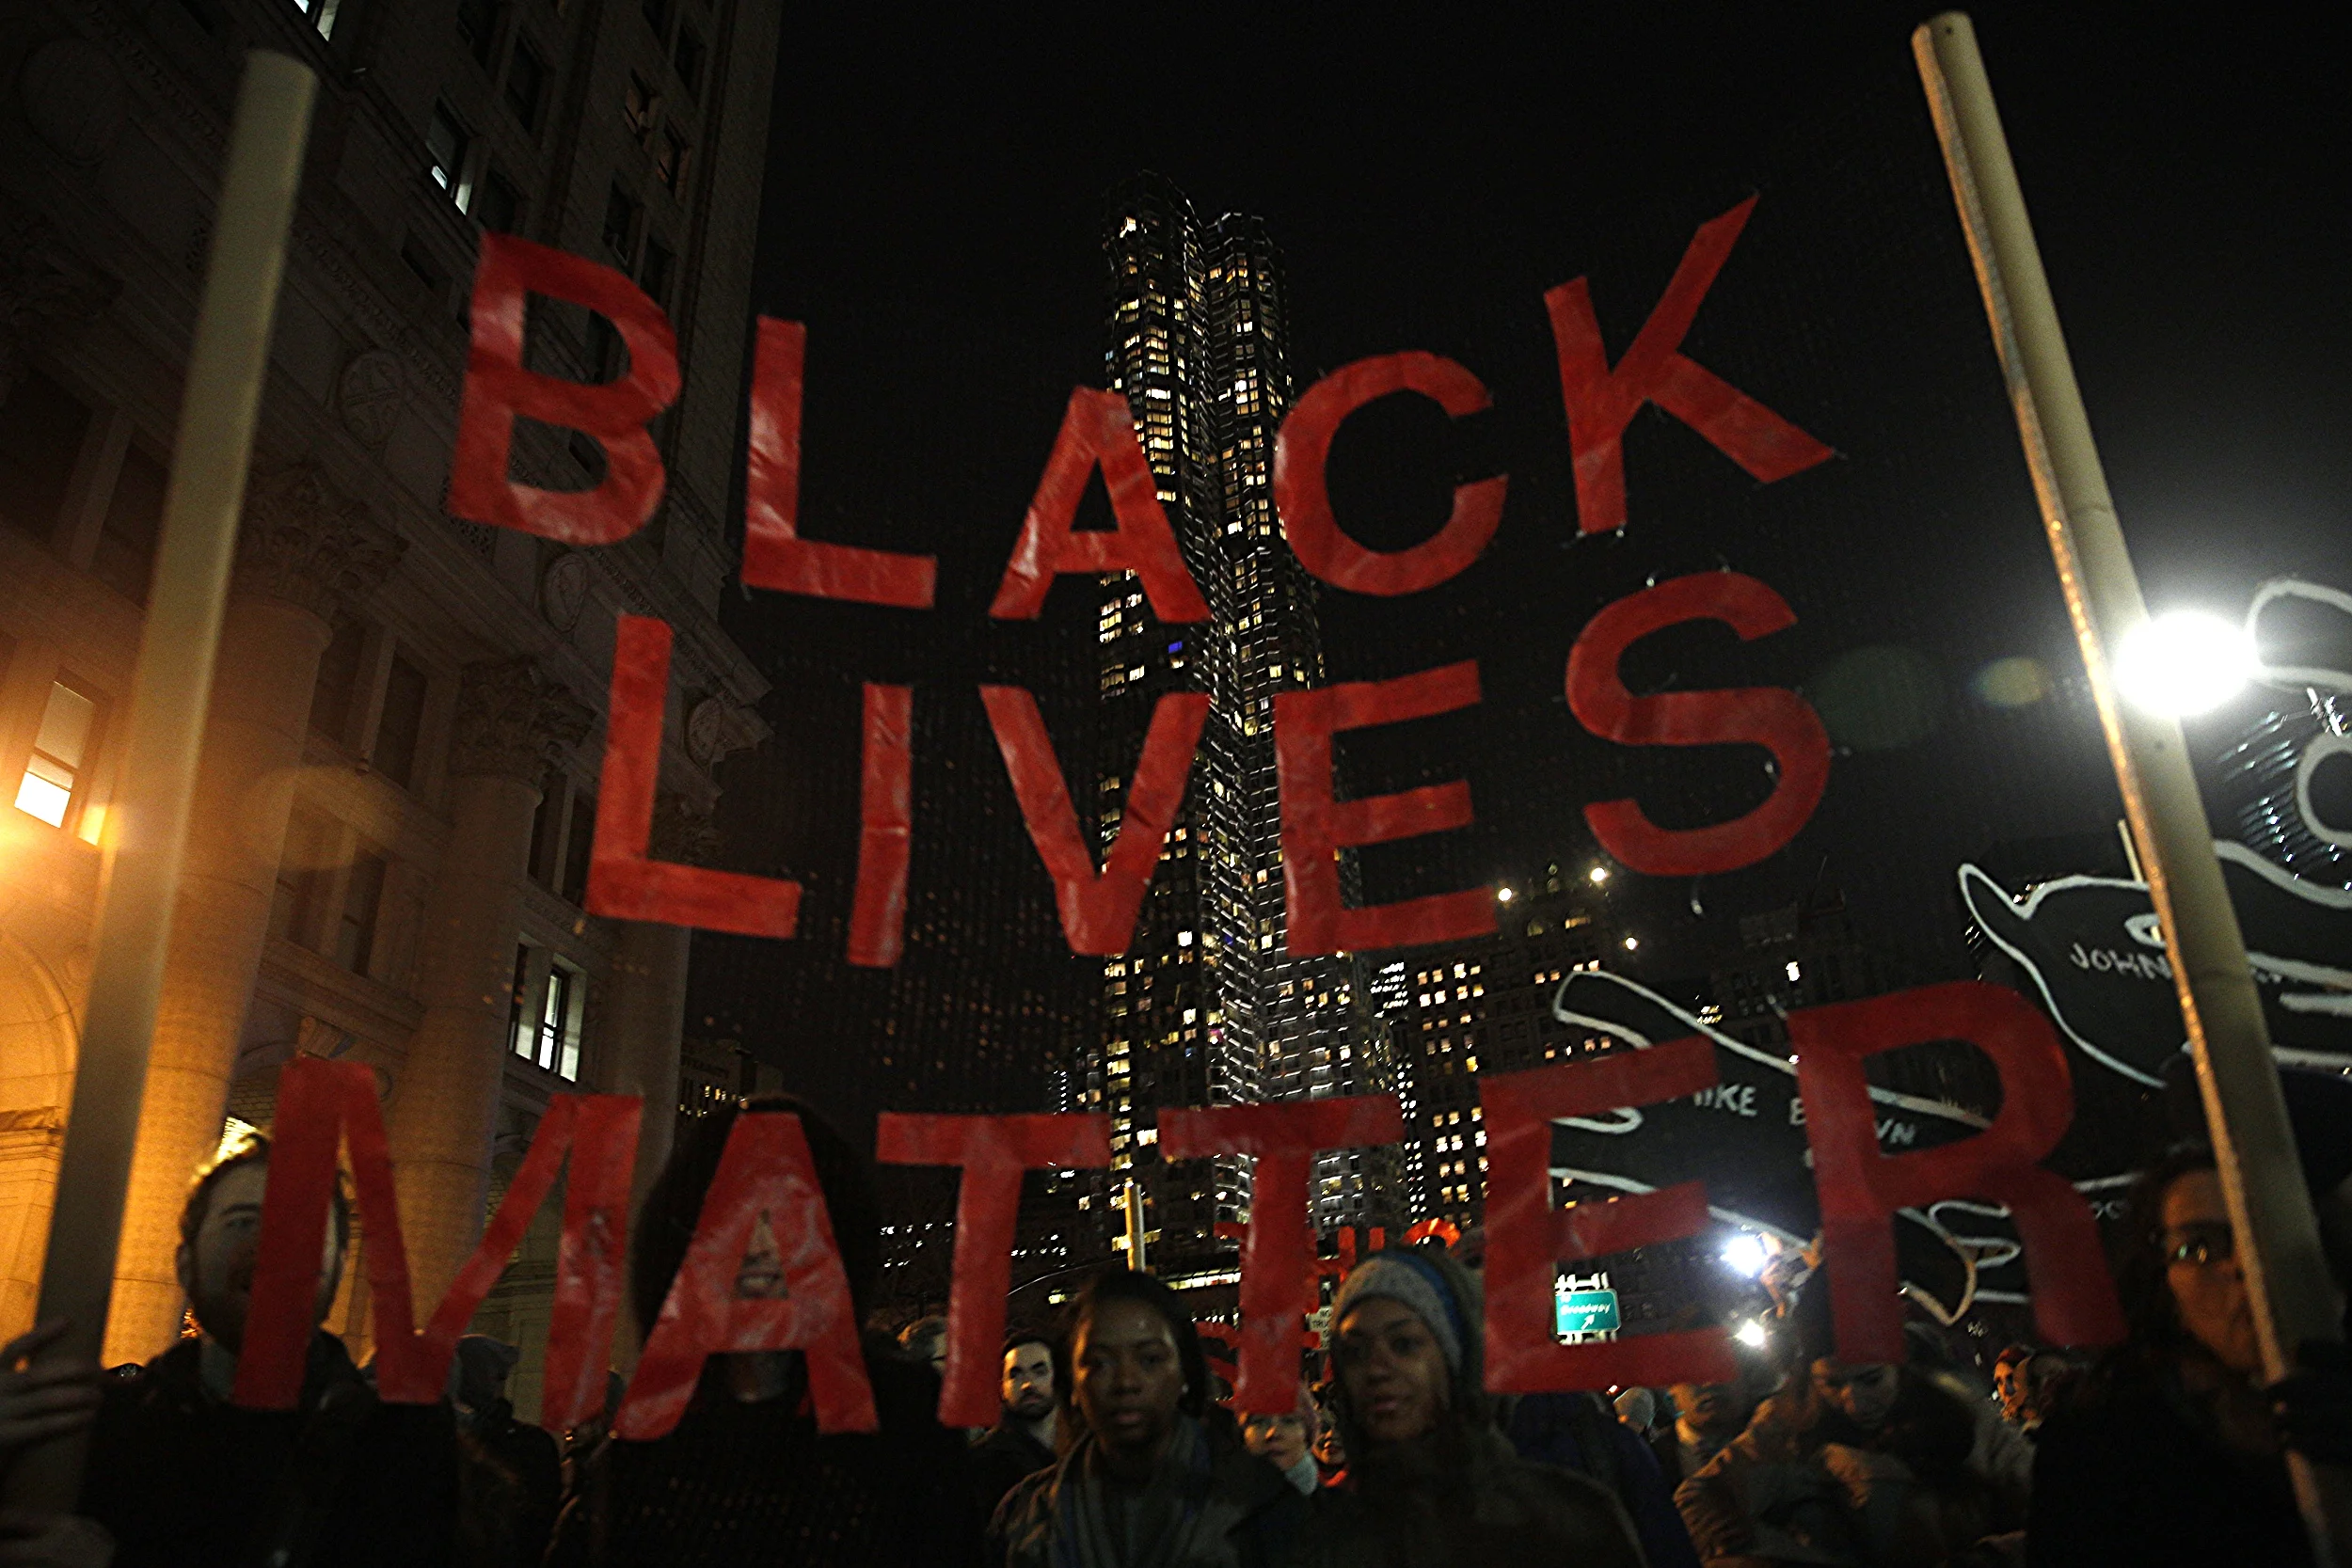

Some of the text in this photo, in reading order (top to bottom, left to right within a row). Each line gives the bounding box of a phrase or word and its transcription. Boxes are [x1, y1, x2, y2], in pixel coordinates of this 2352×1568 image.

[449, 196, 1836, 624] BLACK
[583, 568, 1831, 970] LIVES
[233, 983, 2130, 1441] MATTER
[1693, 1083, 1757, 1117] IKE
